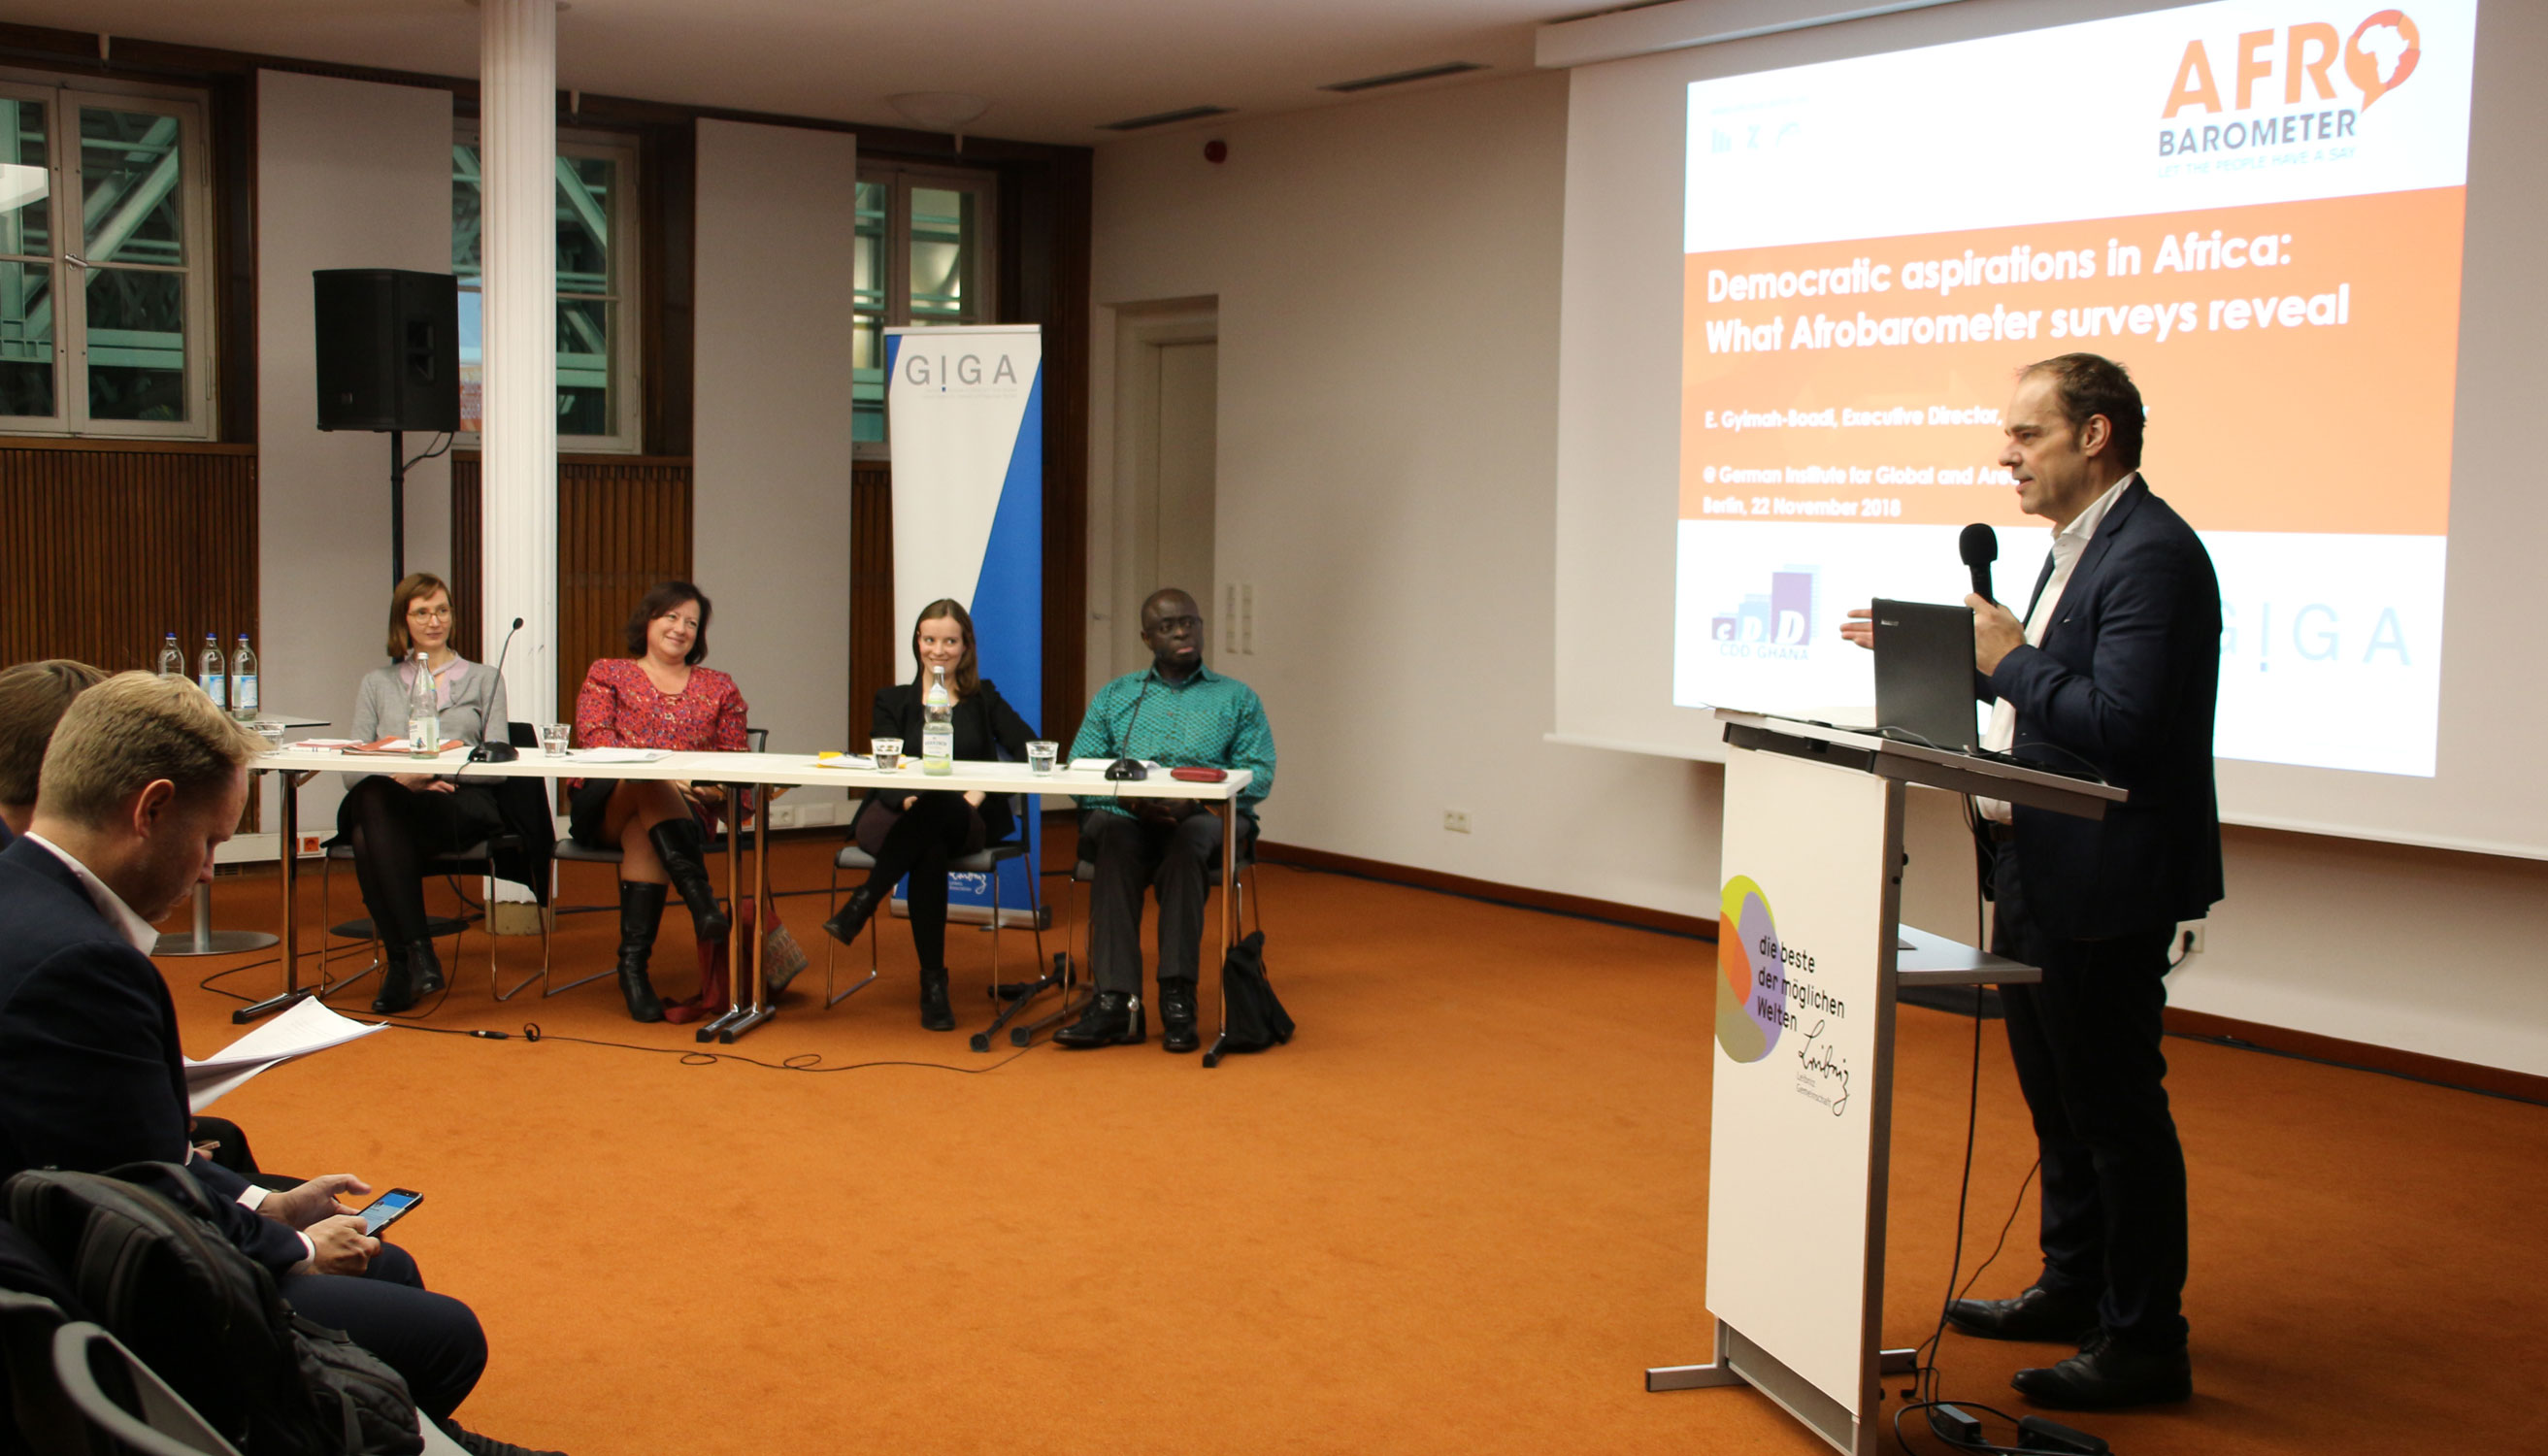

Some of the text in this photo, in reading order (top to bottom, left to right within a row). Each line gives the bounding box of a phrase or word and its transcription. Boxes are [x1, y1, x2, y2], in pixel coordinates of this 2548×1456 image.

[2159, 109, 2357, 156] BAROMETER
[2159, 147, 2357, 178] LET THE PEOPLE HAVE A SAY
[1707, 230, 2292, 303] Democratic aspirations in Africa:
[1706, 283, 2350, 353] What Afrobarometer surveys reveal
[1704, 410, 1718, 429] E.
[1842, 407, 1924, 427] Executive
[1928, 406, 2002, 427] Director,
[1719, 466, 1782, 483] German
[1785, 466, 1847, 483] Institute
[1849, 466, 1872, 484] for
[1875, 466, 1935, 484] Global
[1937, 466, 1974, 485] and
[1703, 496, 1902, 517] Berlin, 22 November 2018
[1720, 643, 1809, 661] CDD GHANA
[1759, 936, 1815, 974] die beste
[1758, 967, 1844, 1019] der möglichen
[1757, 996, 1797, 1031] Welten
